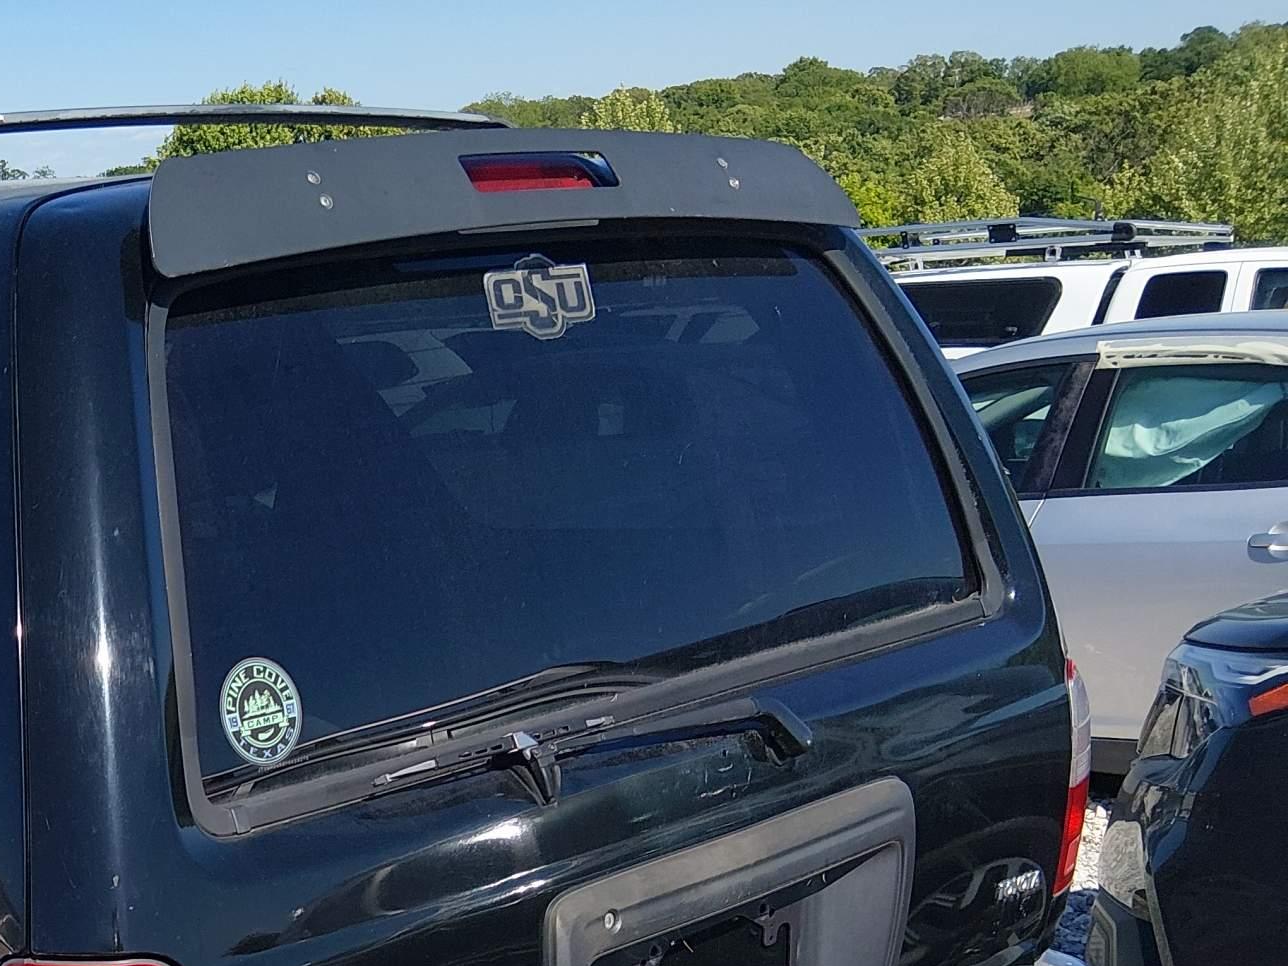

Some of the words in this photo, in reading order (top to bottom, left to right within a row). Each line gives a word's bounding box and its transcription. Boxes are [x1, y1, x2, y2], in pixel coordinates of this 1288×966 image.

[226, 669, 250, 712] PINE
[253, 665, 294, 701] COVE
[228, 717, 239, 729] 19
[247, 715, 279, 728] CAMP
[238, 726, 295, 758] TEXAS
